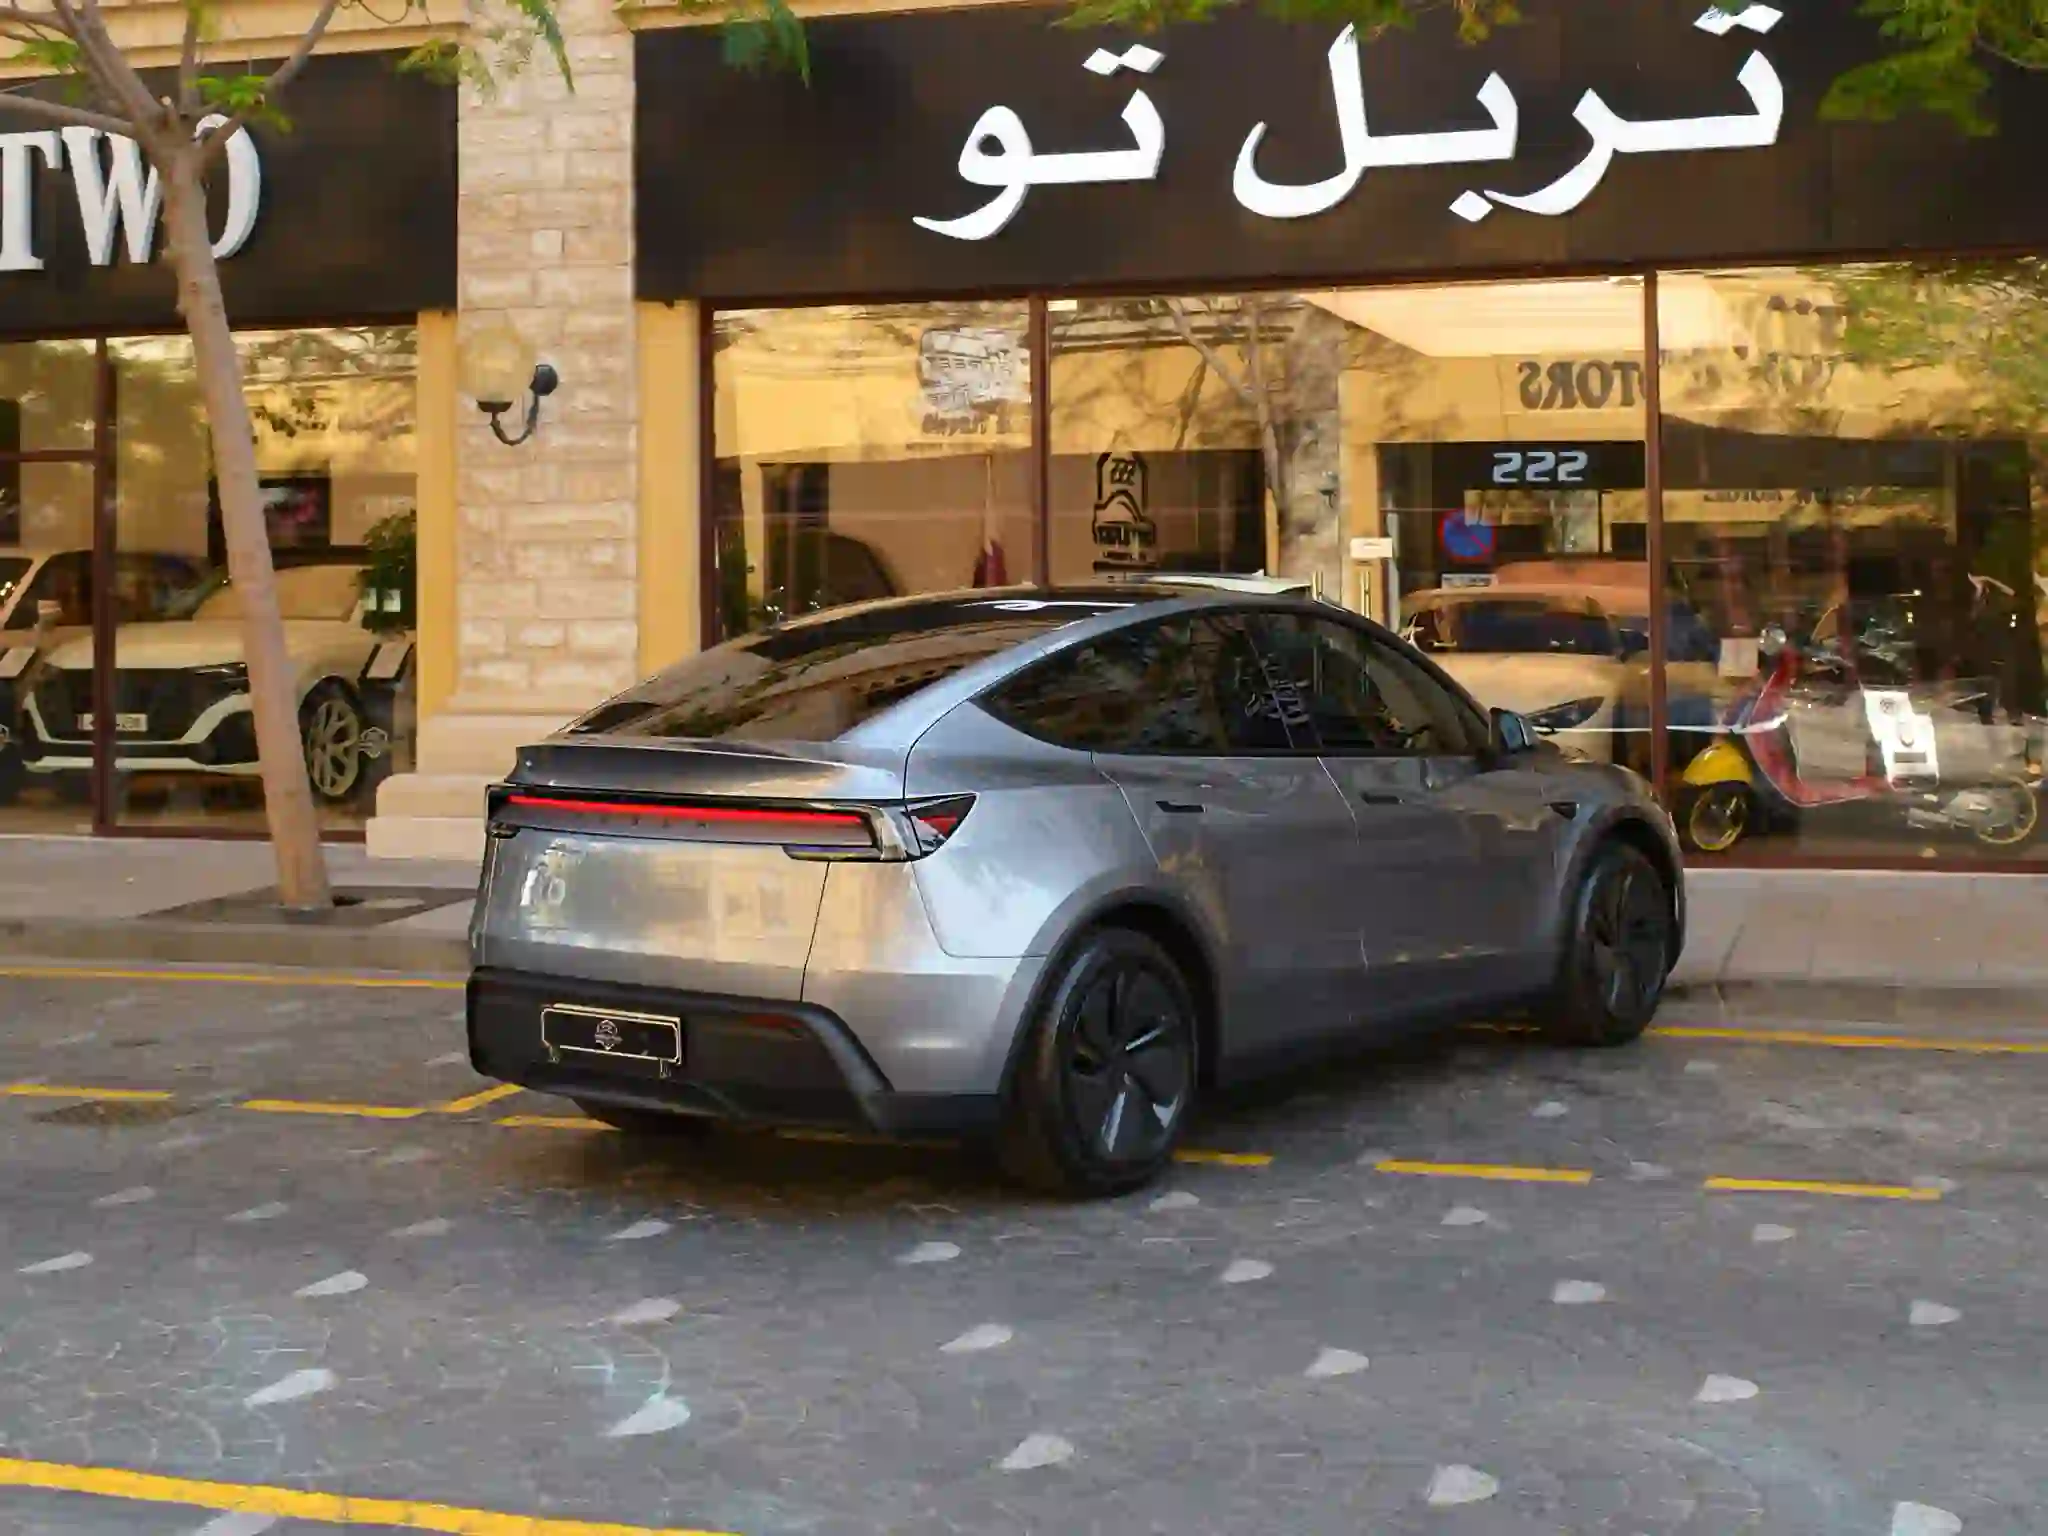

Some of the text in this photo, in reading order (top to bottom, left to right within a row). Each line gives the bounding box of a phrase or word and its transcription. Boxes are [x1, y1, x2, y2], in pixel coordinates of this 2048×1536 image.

[912, 3, 1784, 241] تربل تو
[1491, 450, 1589, 484] 222
